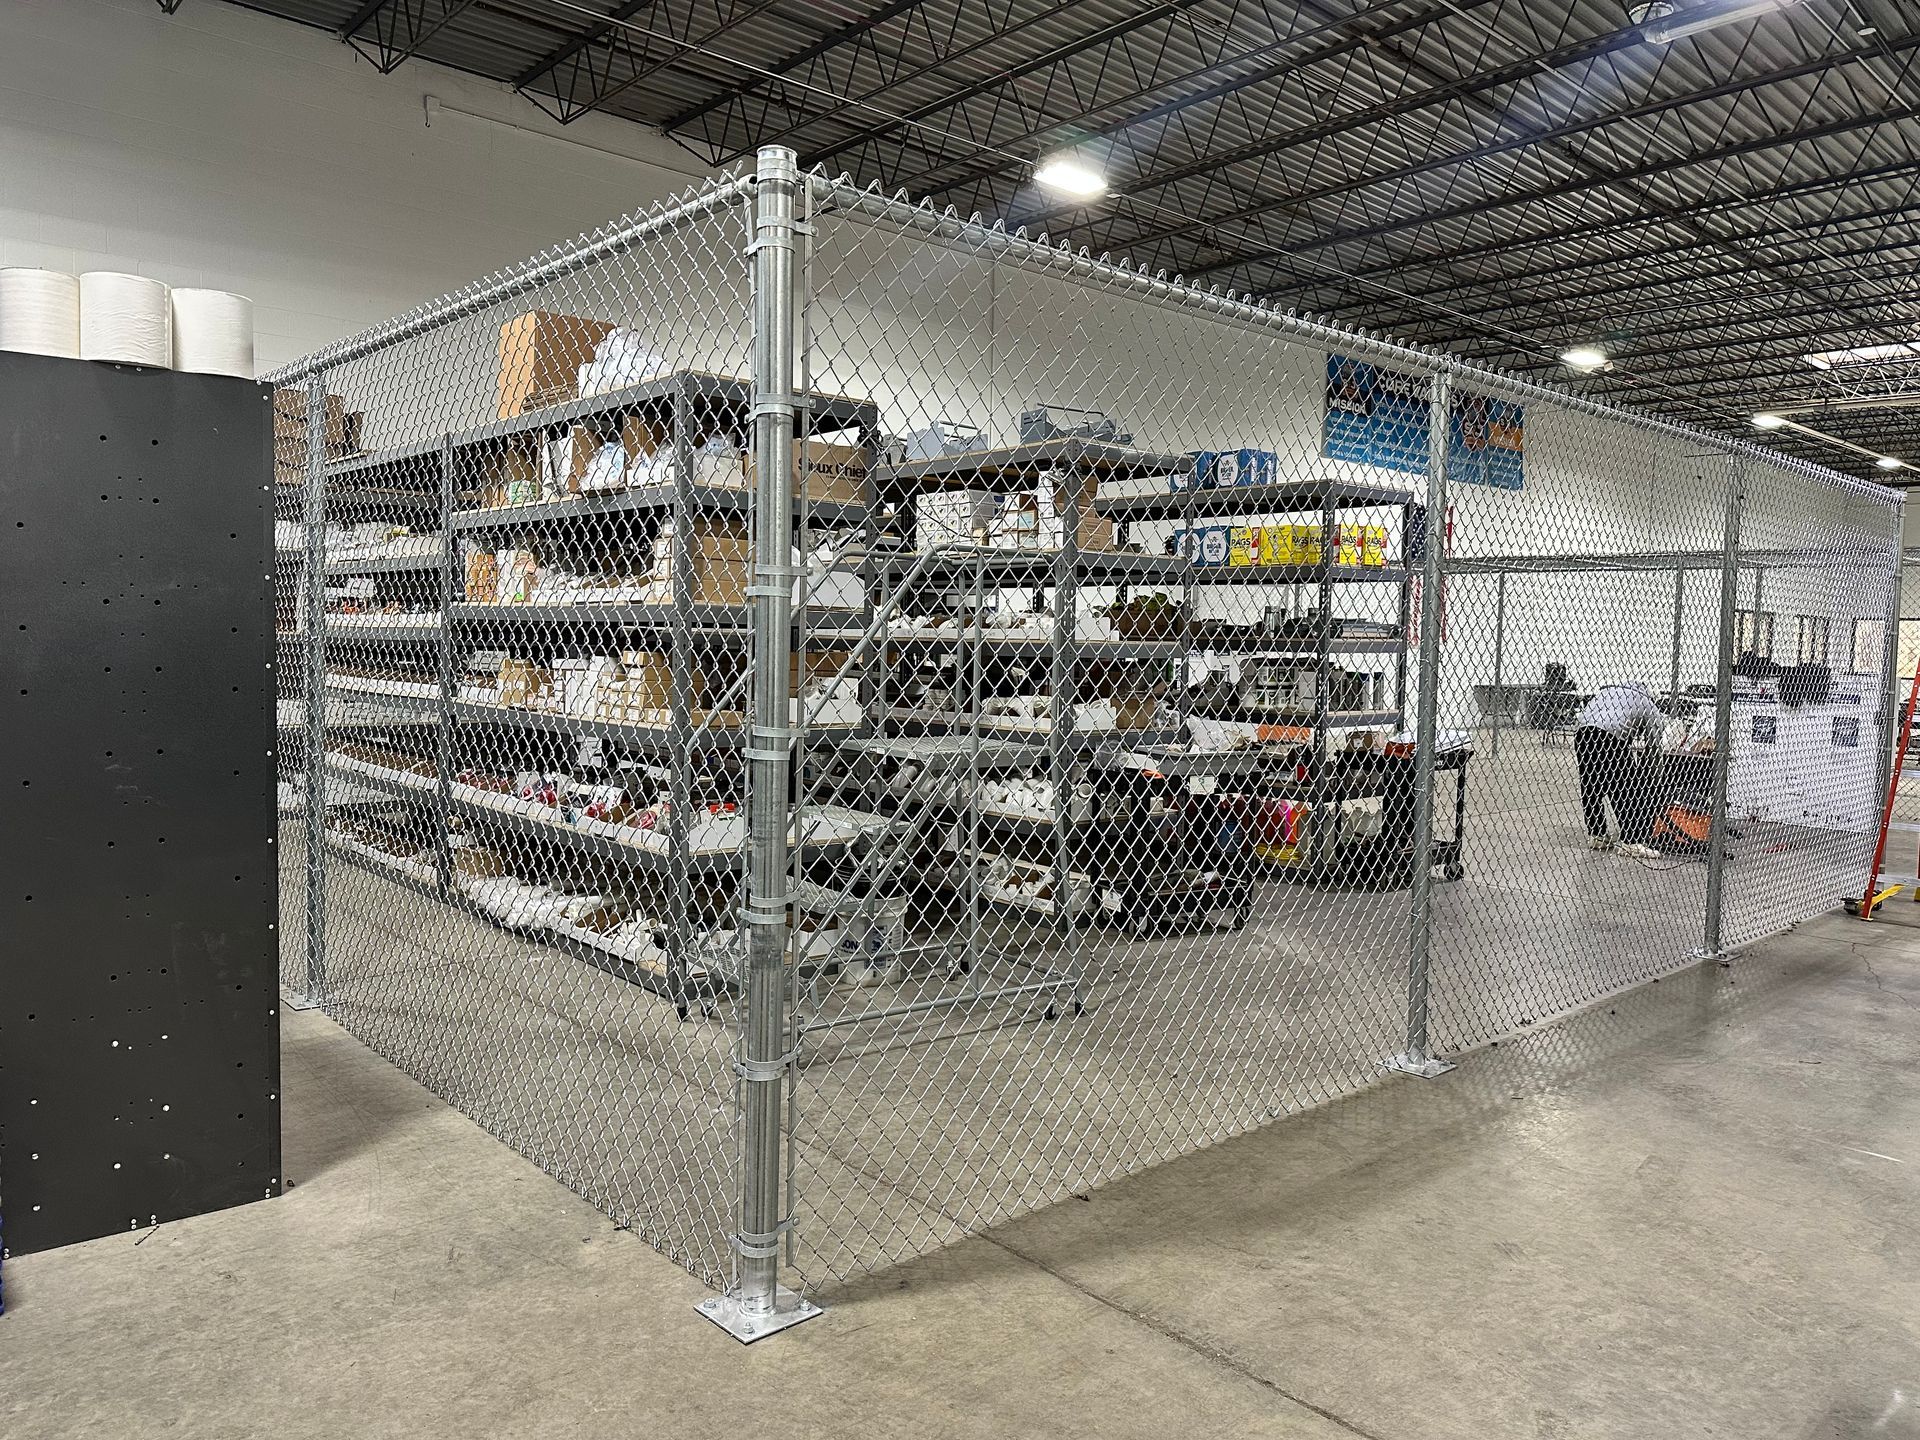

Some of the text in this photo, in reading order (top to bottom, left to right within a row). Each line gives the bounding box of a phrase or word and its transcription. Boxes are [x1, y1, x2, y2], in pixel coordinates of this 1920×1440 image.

[1378, 375, 1411, 397] CORE
[1411, 386, 1458, 409] VAS
[1328, 397, 1367, 416] MISSION
[798, 457, 833, 474] Sioux
[836, 462, 867, 479] Chief
[1231, 538, 1251, 546] RAGS
